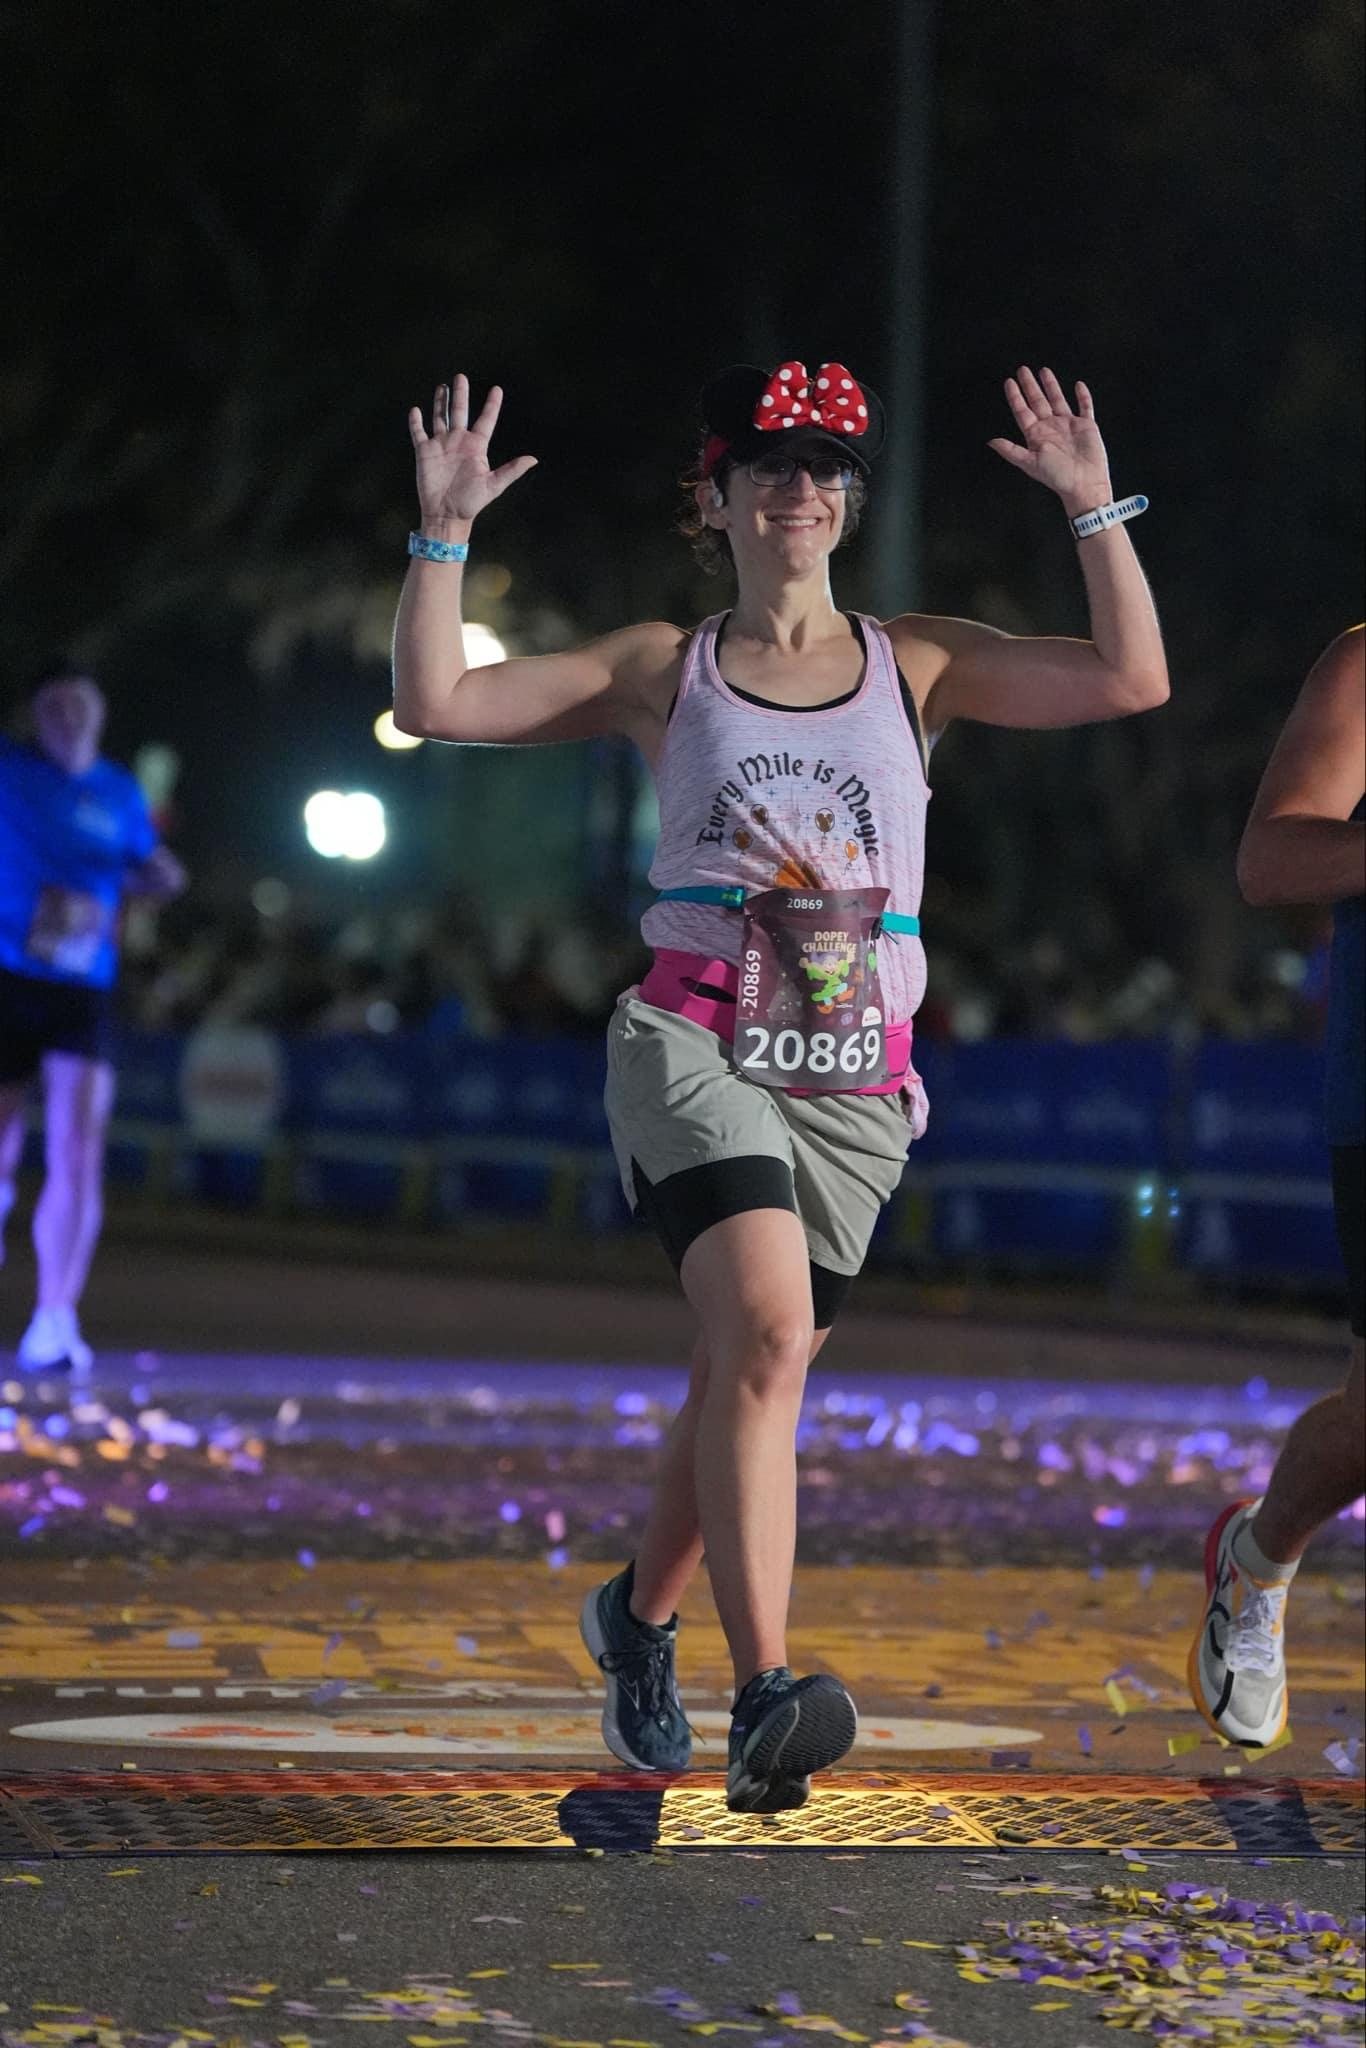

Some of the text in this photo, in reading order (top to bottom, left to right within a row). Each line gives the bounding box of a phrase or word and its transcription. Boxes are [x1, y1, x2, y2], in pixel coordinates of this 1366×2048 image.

[696, 751, 879, 856] Every Mile is Magic
[787, 897, 824, 910] 20869
[802, 942, 857, 953] CHALLENGE
[814, 931, 849, 942] DOPEY
[742, 950, 761, 1009] 20869
[742, 1027, 881, 1073] 20869
